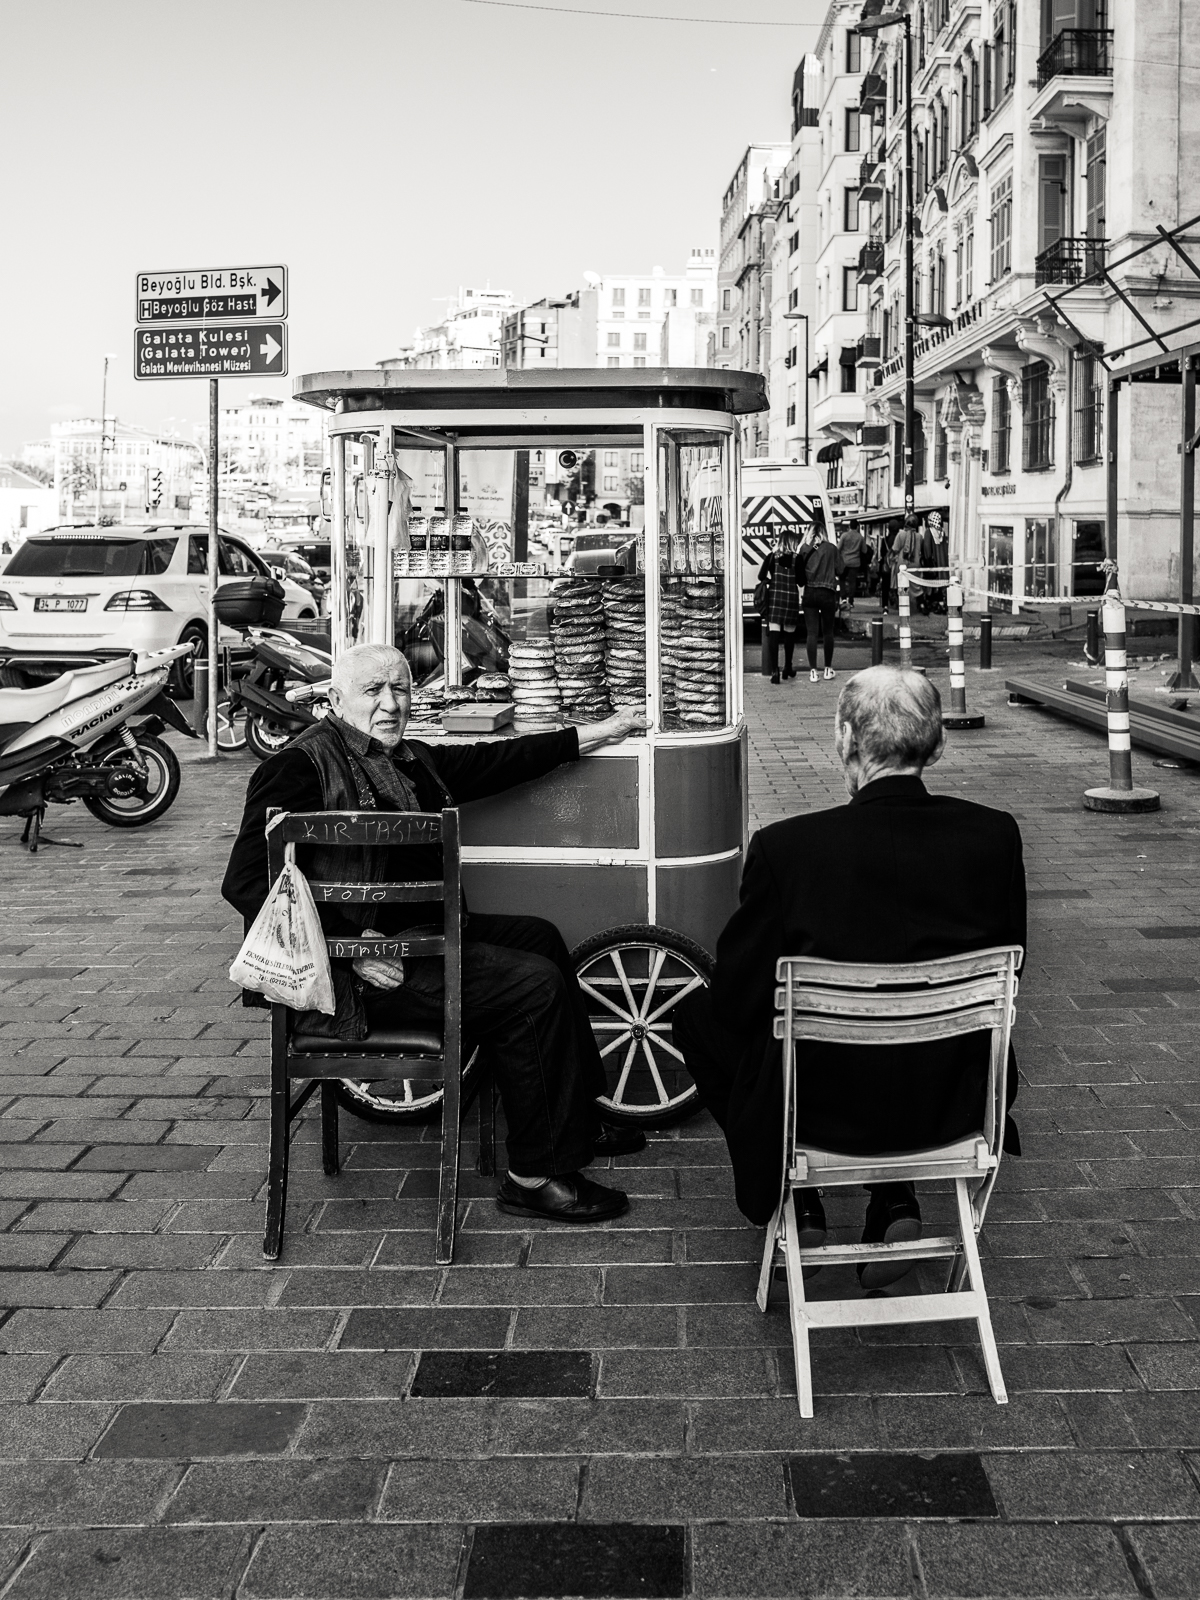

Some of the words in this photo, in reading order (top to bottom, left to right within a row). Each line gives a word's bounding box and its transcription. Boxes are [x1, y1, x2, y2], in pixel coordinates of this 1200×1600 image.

[141, 275, 195, 295] Beyoğlu
[201, 273, 226, 289] Bld.
[230, 272, 257, 289] Bşk.
[153, 300, 199, 317] Beyoğlu
[203, 298, 224, 312] Göz
[227, 297, 256, 311] Hast.
[142, 332, 193, 344] Galata
[199, 330, 248, 343] Kulesi
[140, 346, 195, 361] (Galata
[201, 344, 251, 358] Tower)
[140, 362, 165, 374] Galata
[166, 360, 221, 373] Mevlevihanesi
[223, 359, 251, 371] Müzesi
[40, 600, 49, 609] 34
[55, 600, 61, 609] P
[67, 600, 85, 609] 1077
[69, 704, 125, 739] RACING
[323, 887, 387, 901] FOTO
